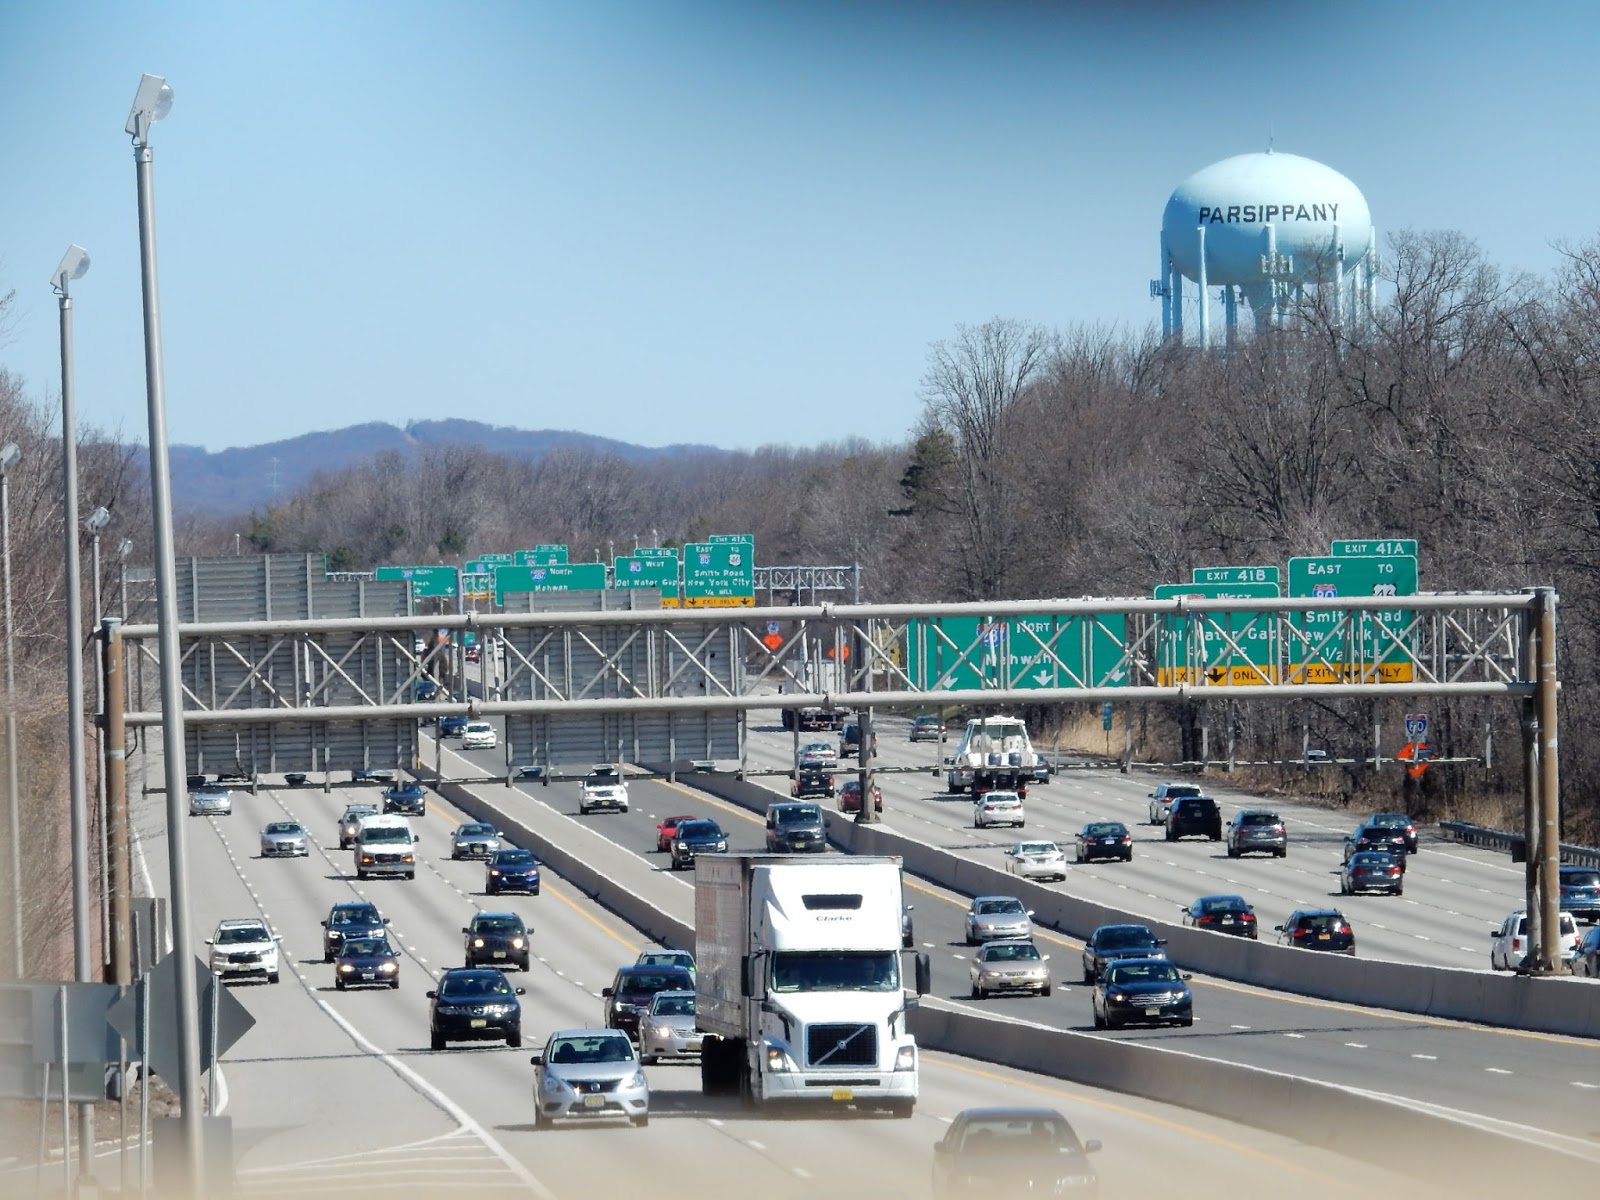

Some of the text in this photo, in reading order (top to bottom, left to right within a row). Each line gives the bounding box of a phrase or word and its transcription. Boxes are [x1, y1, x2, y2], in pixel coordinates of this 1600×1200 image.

[1199, 203, 1339, 224] PARSIPPANY
[1345, 542, 1405, 555] EXIT 41A
[694, 569, 744, 577] Smith Road
[1206, 569, 1266, 581] EXIT 41B
[1307, 562, 1394, 575] EAST TO
[634, 579, 658, 587] Water
[662, 579, 678, 588] Gap
[688, 579, 750, 587] New York City
[1305, 610, 1347, 623] Smit
[1325, 647, 1344, 661] 1/2
